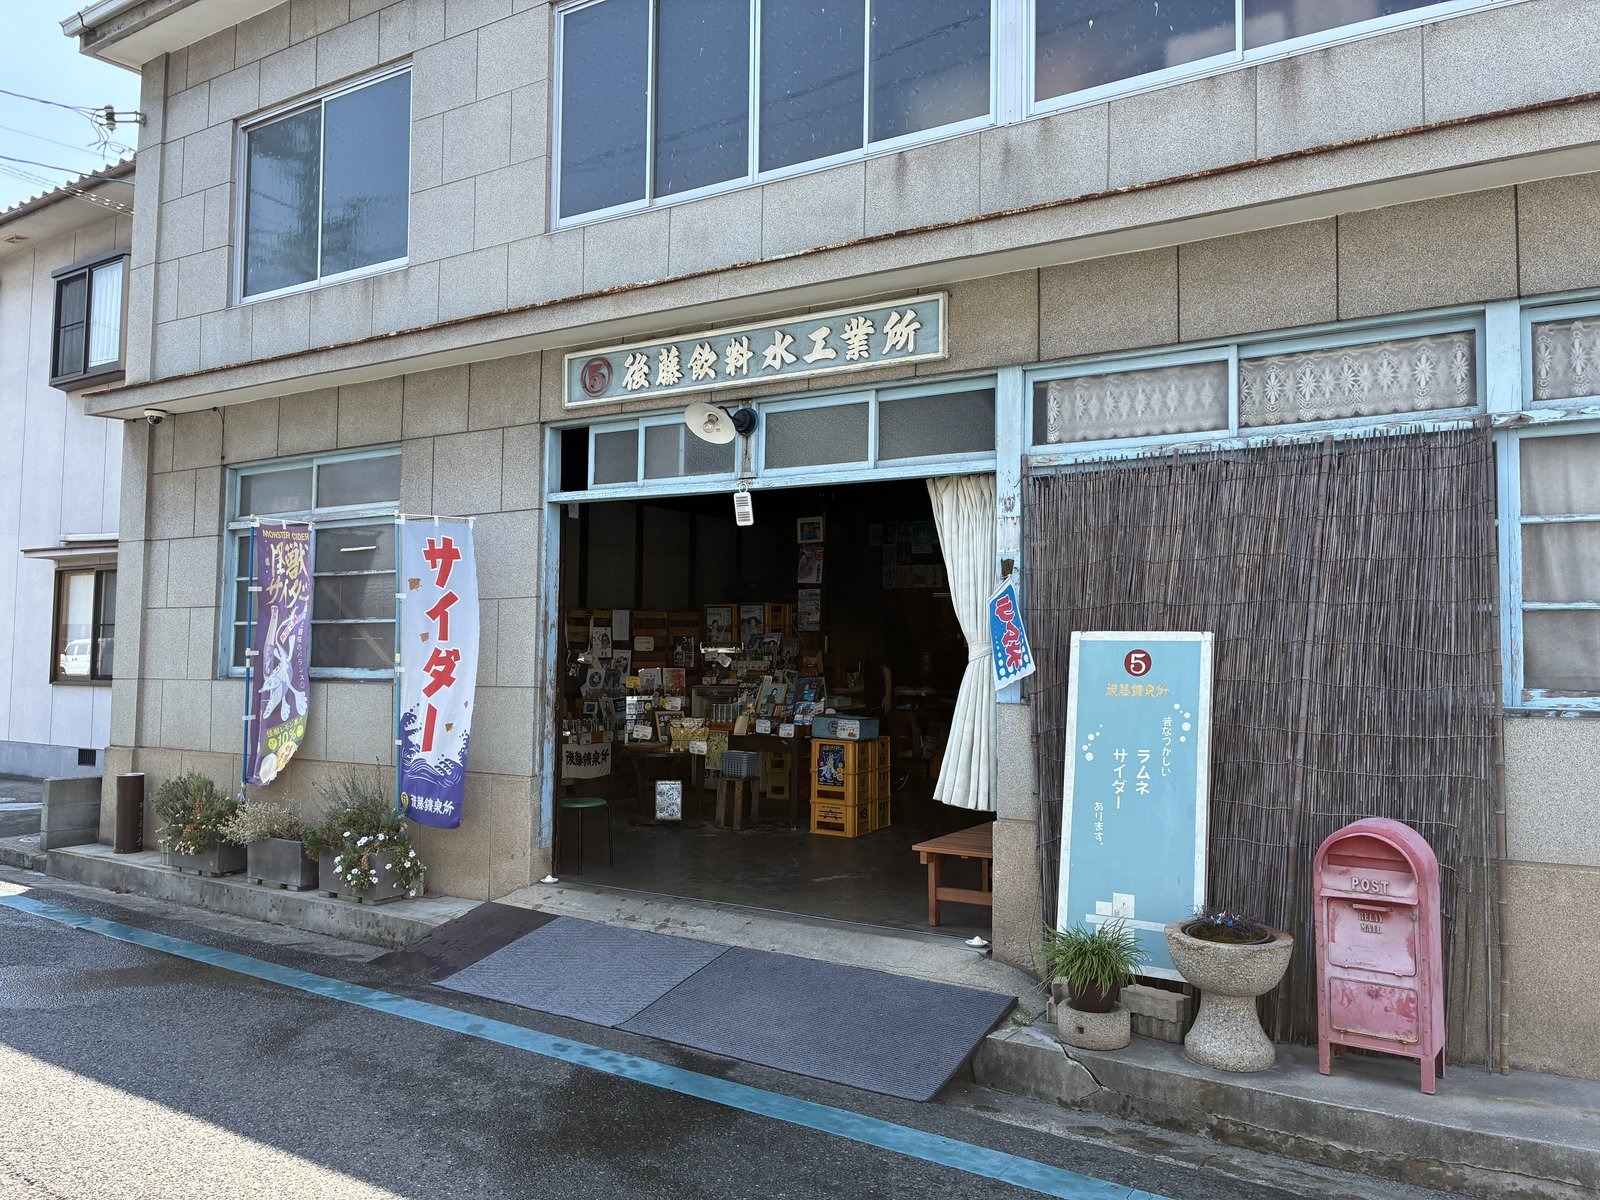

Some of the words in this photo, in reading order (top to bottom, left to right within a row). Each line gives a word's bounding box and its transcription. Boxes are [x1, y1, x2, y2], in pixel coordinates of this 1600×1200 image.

[622, 308, 923, 391] 後藤飲料水工業所
[262, 529, 291, 539] MONSTER
[291, 532, 310, 541] CIDER
[422, 535, 463, 753] サイダー
[1135, 749, 1151, 795] ラムネ
[1161, 716, 1172, 777] 昔なつかしい
[1112, 748, 1128, 810] サイダー
[1351, 876, 1389, 894] POST
